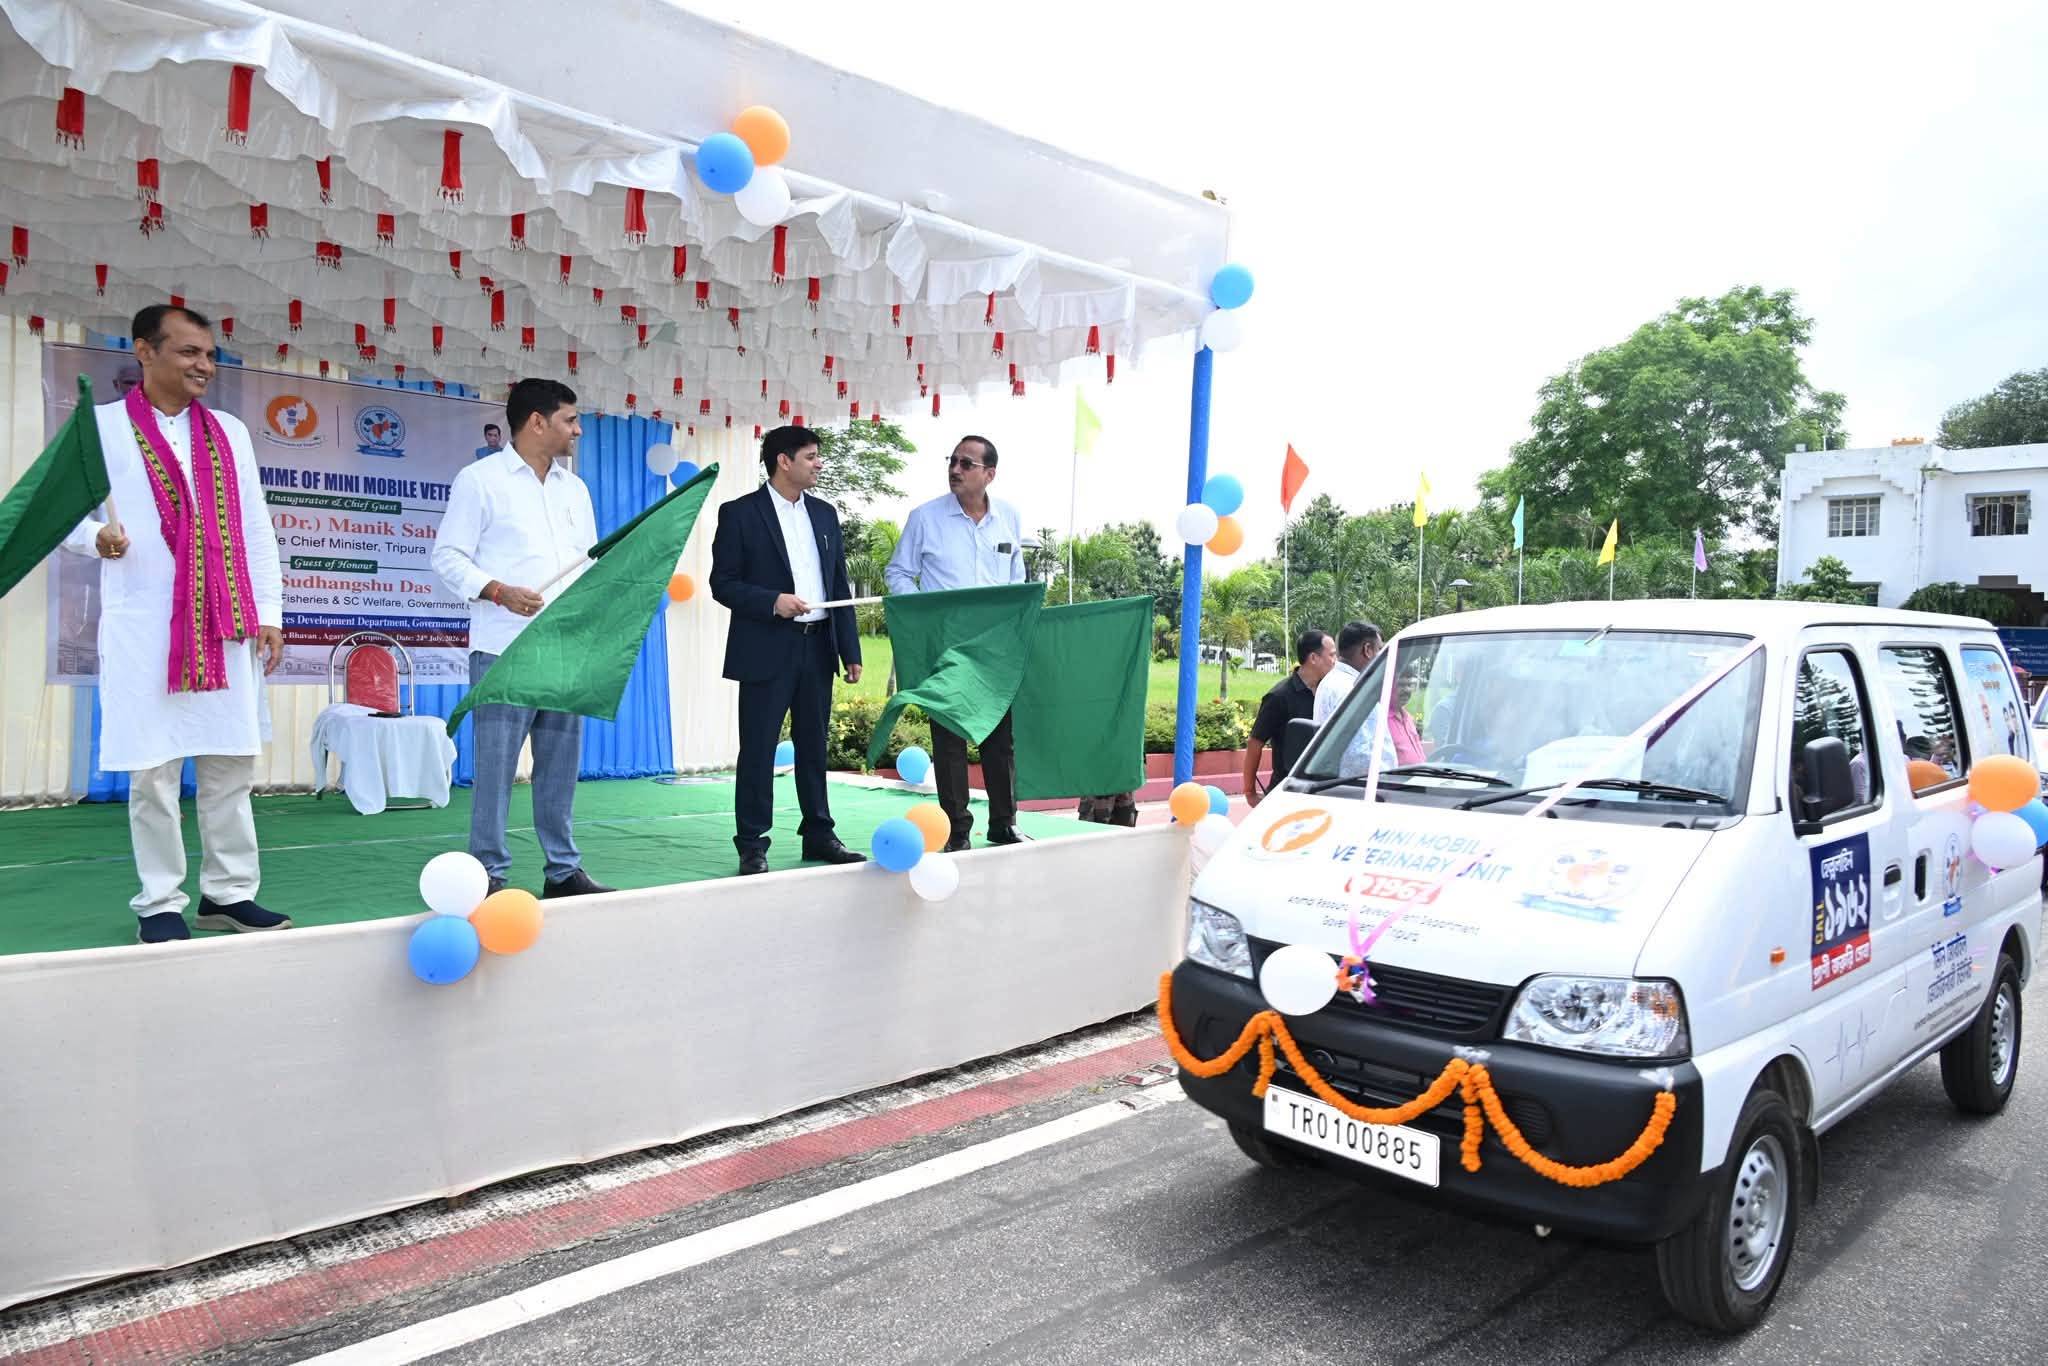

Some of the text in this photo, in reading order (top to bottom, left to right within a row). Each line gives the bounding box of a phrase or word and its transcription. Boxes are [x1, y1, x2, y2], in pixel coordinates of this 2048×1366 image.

[302, 470, 321, 490] OF
[324, 472, 359, 494] MINI
[363, 475, 417, 499] MOBILE
[270, 493, 398, 512] Inaugurator & Chief Guest
[271, 512, 321, 532] (Dr.)
[328, 517, 396, 537] Manik
[291, 535, 326, 548] Chief
[385, 541, 427, 555] Tripura
[294, 558, 373, 570] Guest of Honour
[282, 574, 432, 594] Sudhangshu Das
[333, 595, 340, 605] &
[343, 596, 360, 606] SC
[407, 599, 465, 610] Government
[297, 614, 355, 627] Development
[411, 619, 460, 629] Government
[1368, 828, 1416, 846] MINI
[1332, 845, 1456, 873] VEERINARY
[1815, 902, 1825, 945] CALL
[1288, 1102, 1422, 1170] TR01Q0885
